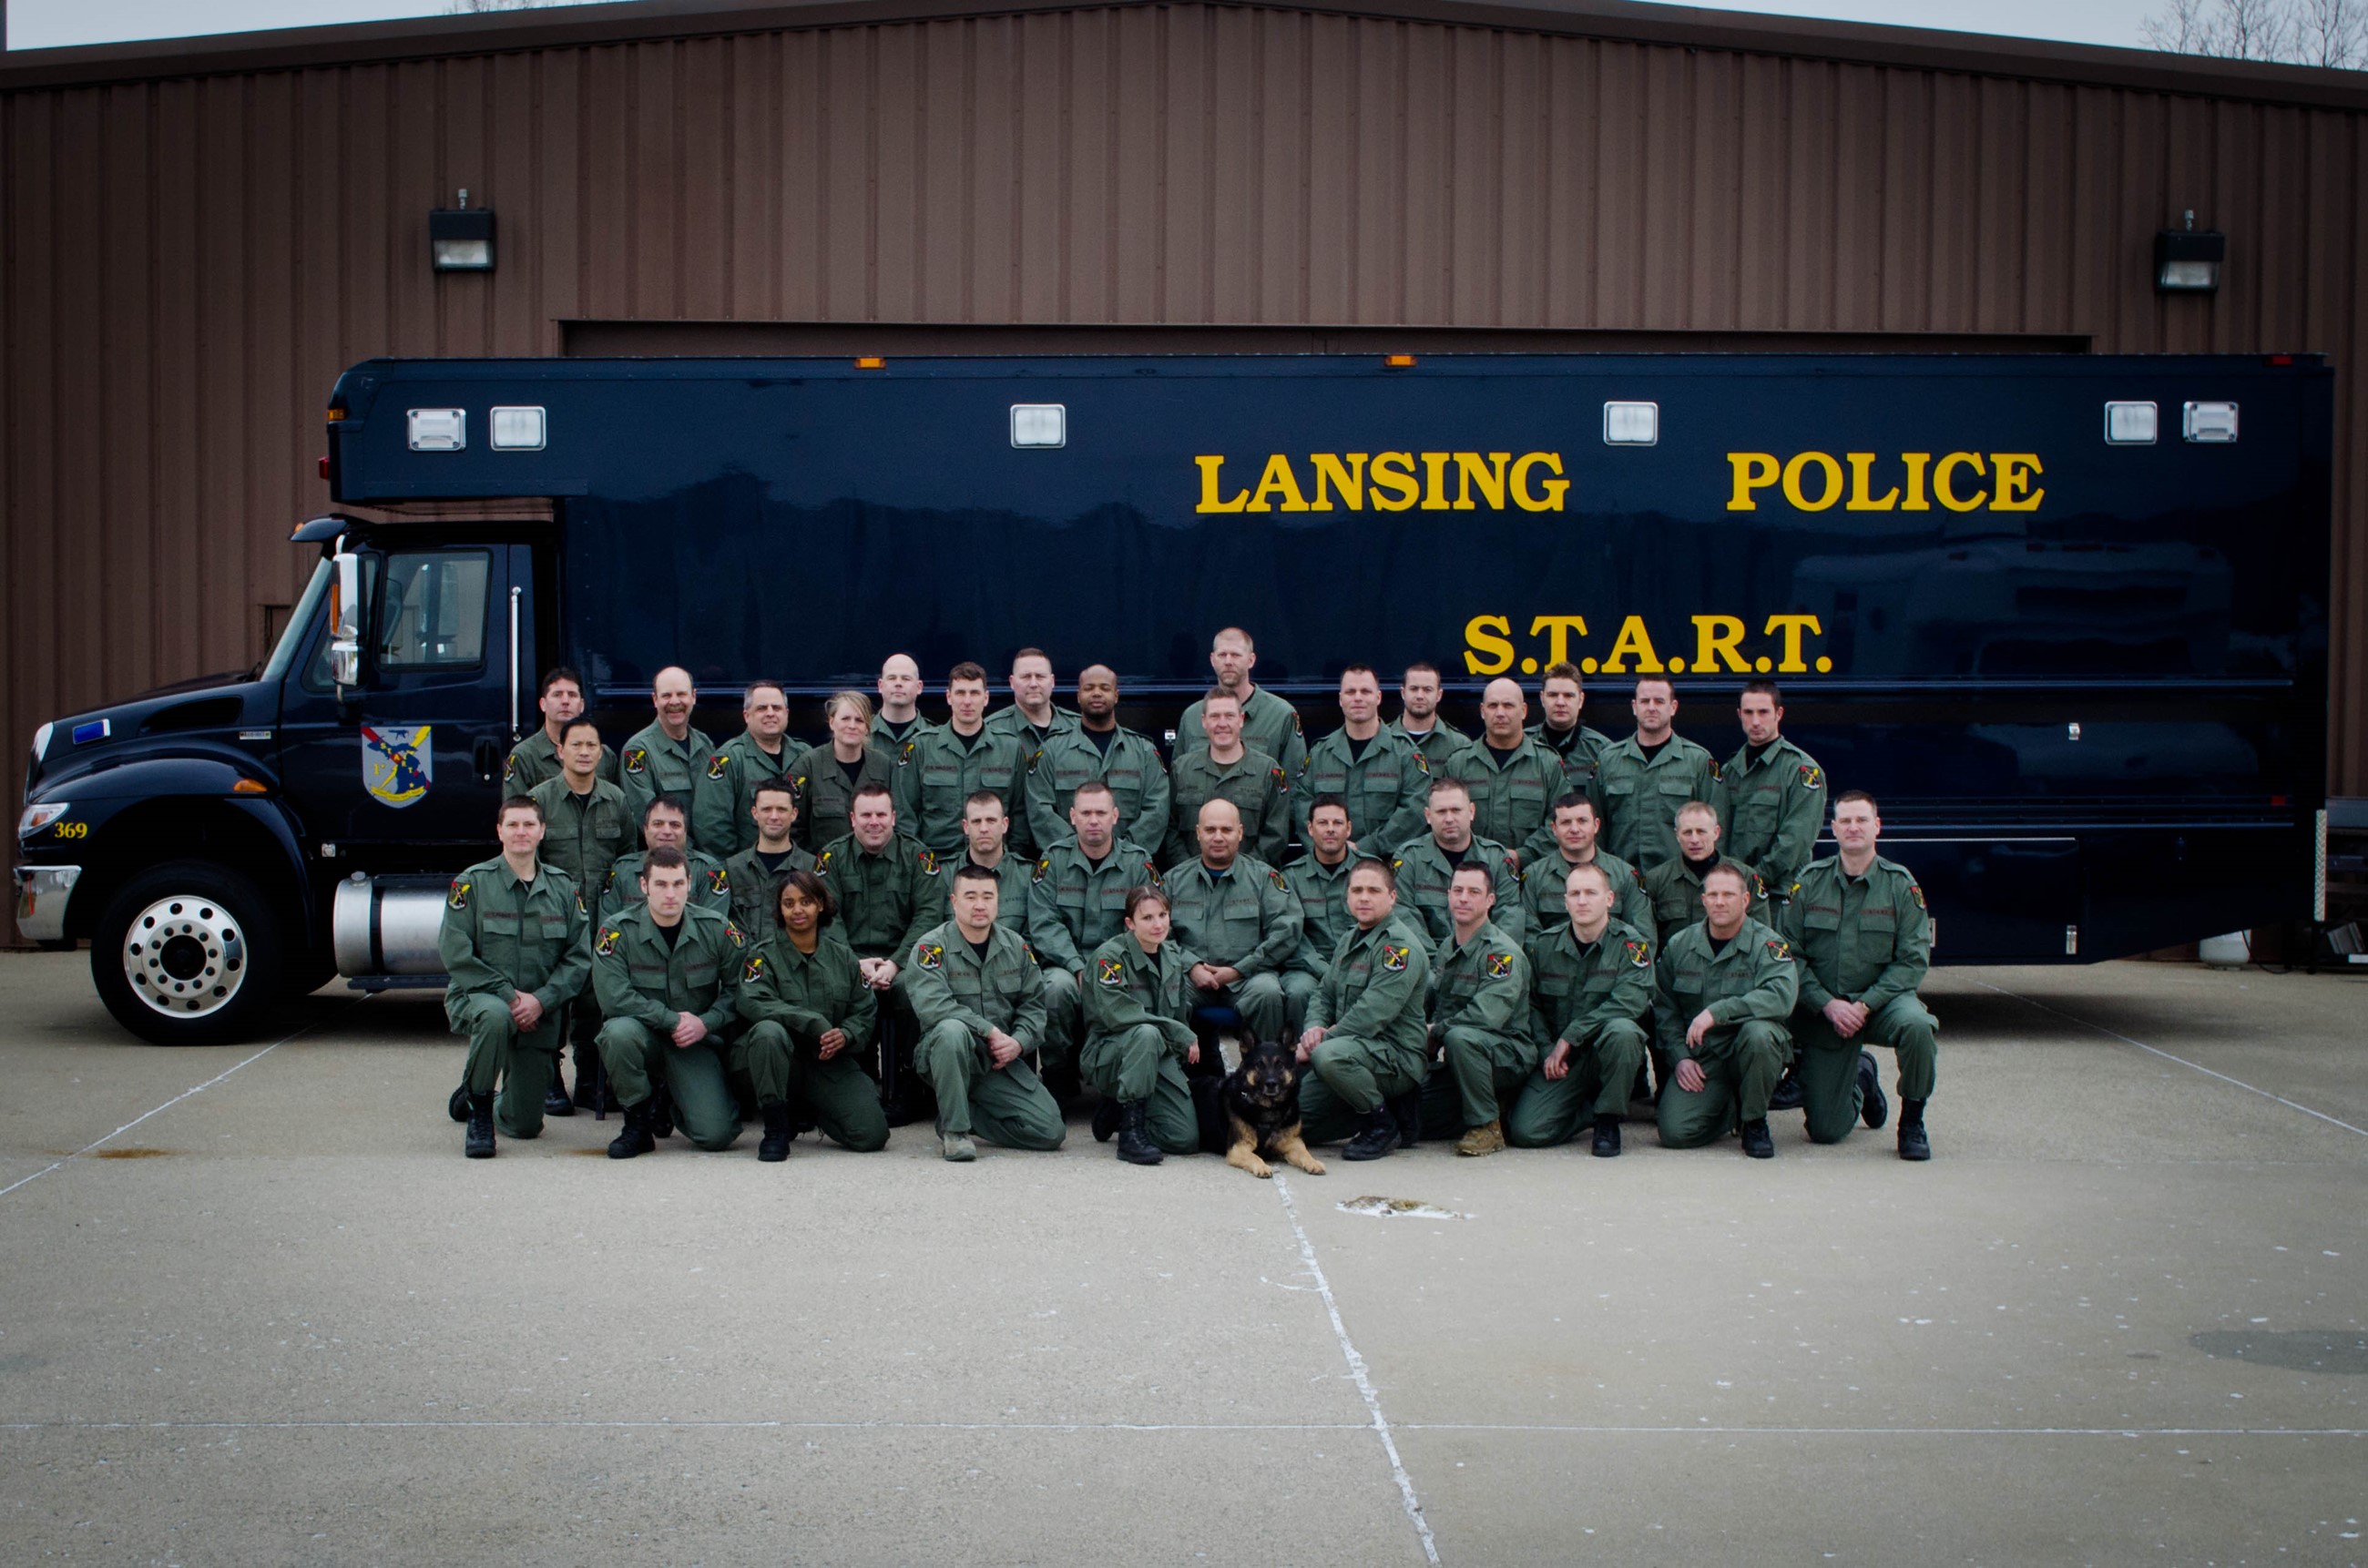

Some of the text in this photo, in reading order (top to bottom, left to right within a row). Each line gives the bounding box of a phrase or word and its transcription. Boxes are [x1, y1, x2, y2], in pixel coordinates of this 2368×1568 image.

[1195, 452, 2046, 514] LANSING POLICE
[1464, 615, 1833, 676] S.T.A.R.T.
[54, 821, 88, 839] 369
